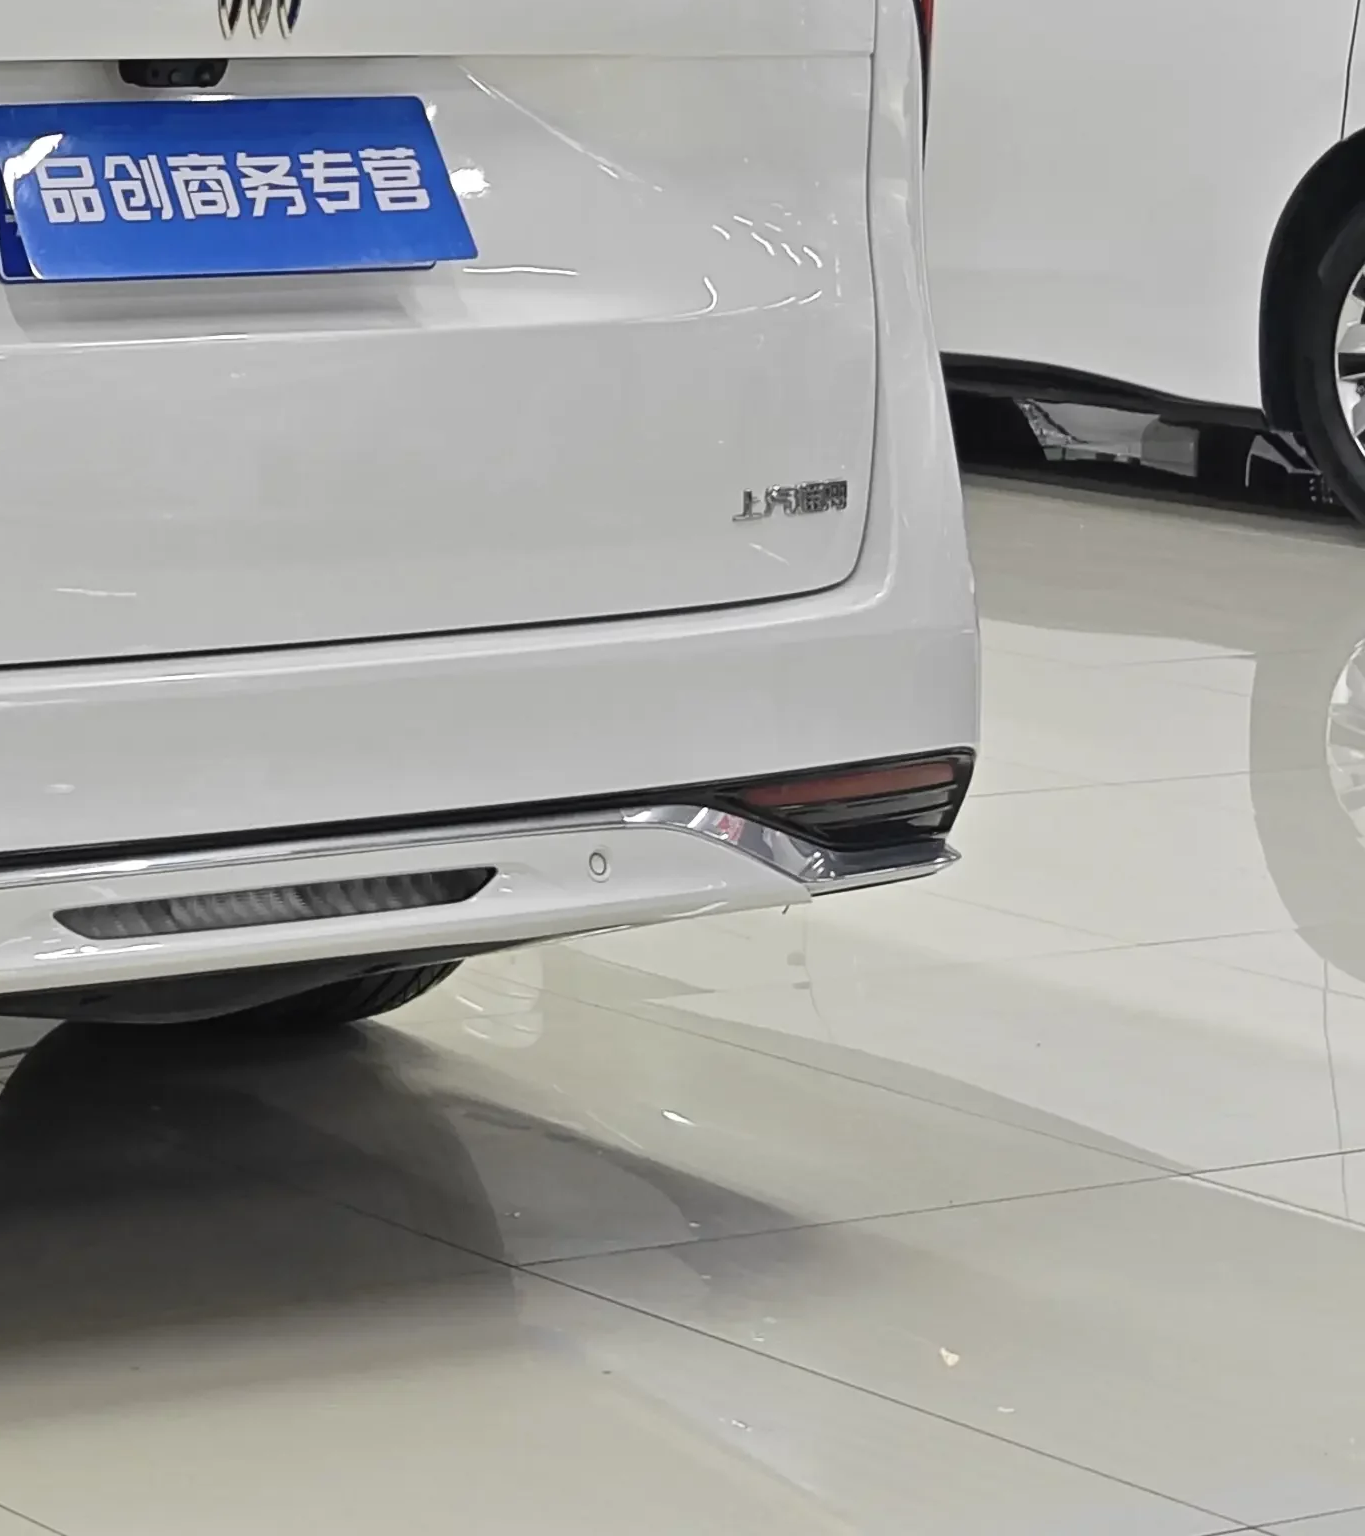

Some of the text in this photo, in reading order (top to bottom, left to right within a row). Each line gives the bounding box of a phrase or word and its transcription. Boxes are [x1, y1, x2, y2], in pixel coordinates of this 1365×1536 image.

[36, 146, 431, 224] 品创商务专营
